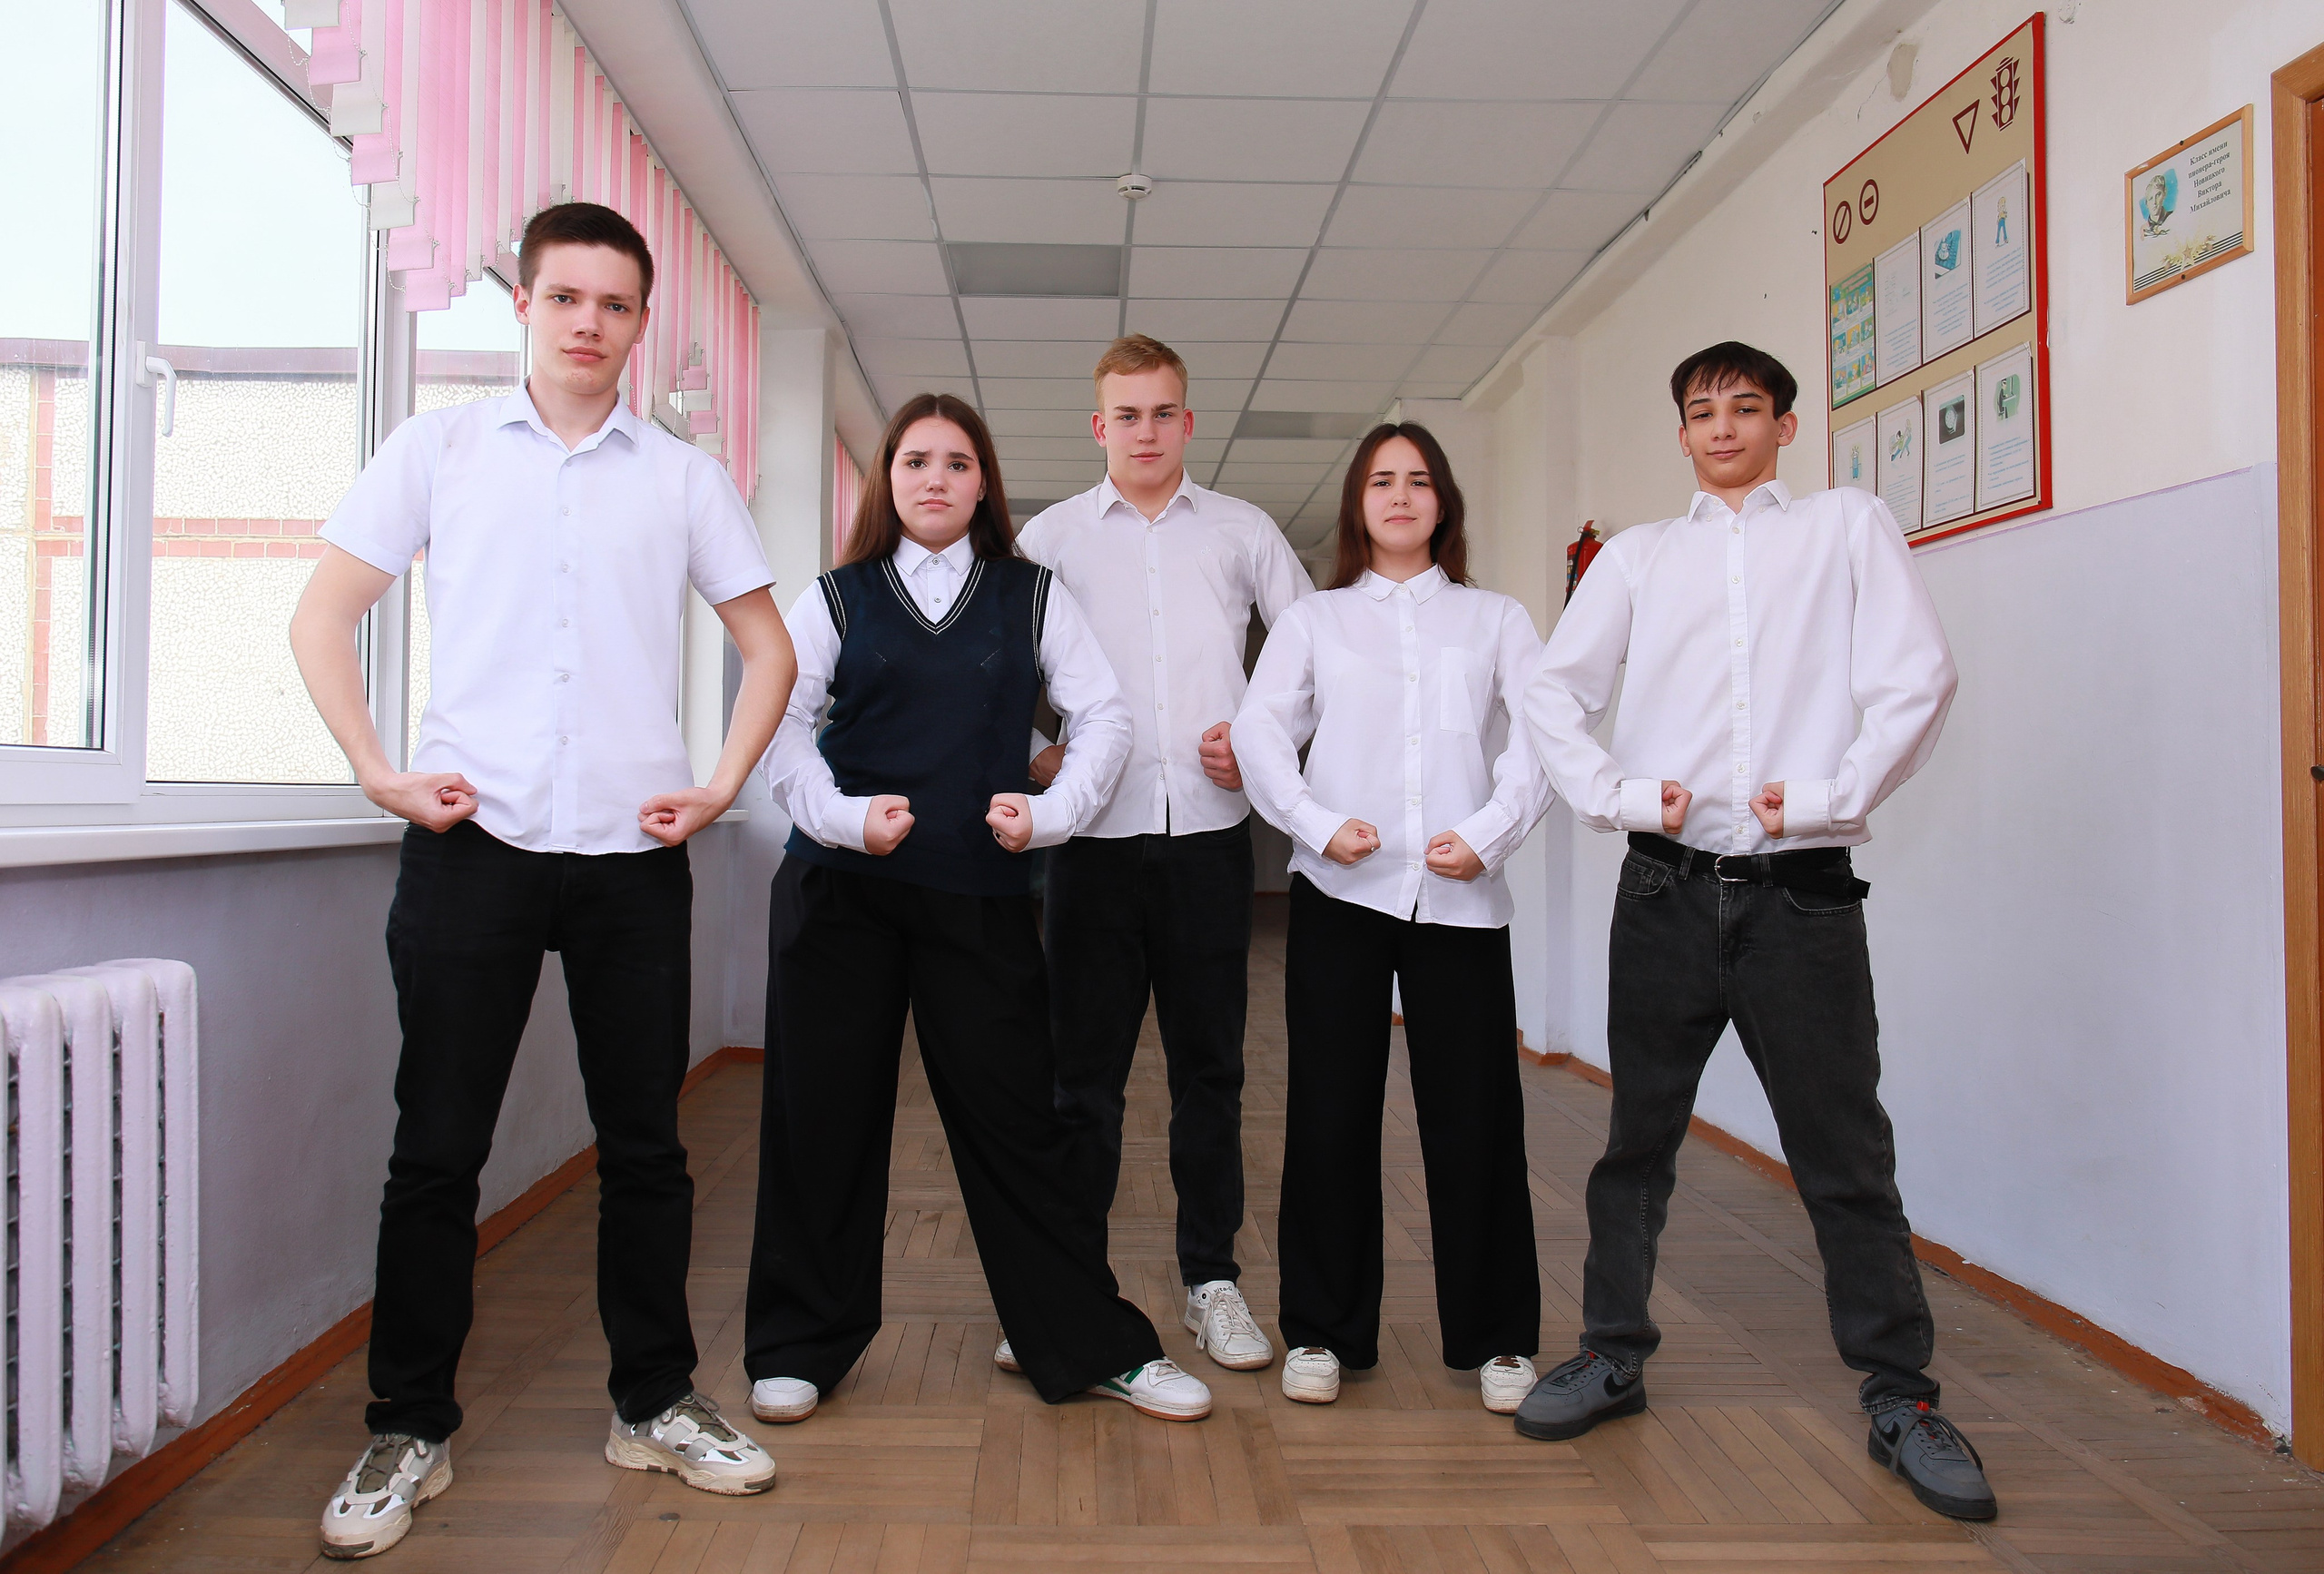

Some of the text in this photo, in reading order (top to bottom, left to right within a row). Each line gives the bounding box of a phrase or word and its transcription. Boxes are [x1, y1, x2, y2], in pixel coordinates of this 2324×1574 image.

[2190, 142, 2228, 165] Класс имени
[2188, 152, 2230, 179] пионера-героя
[2193, 167, 2225, 188] Новицкого
[2190, 189, 2230, 213] Михайловича
[2197, 181, 2222, 198] Виктора
